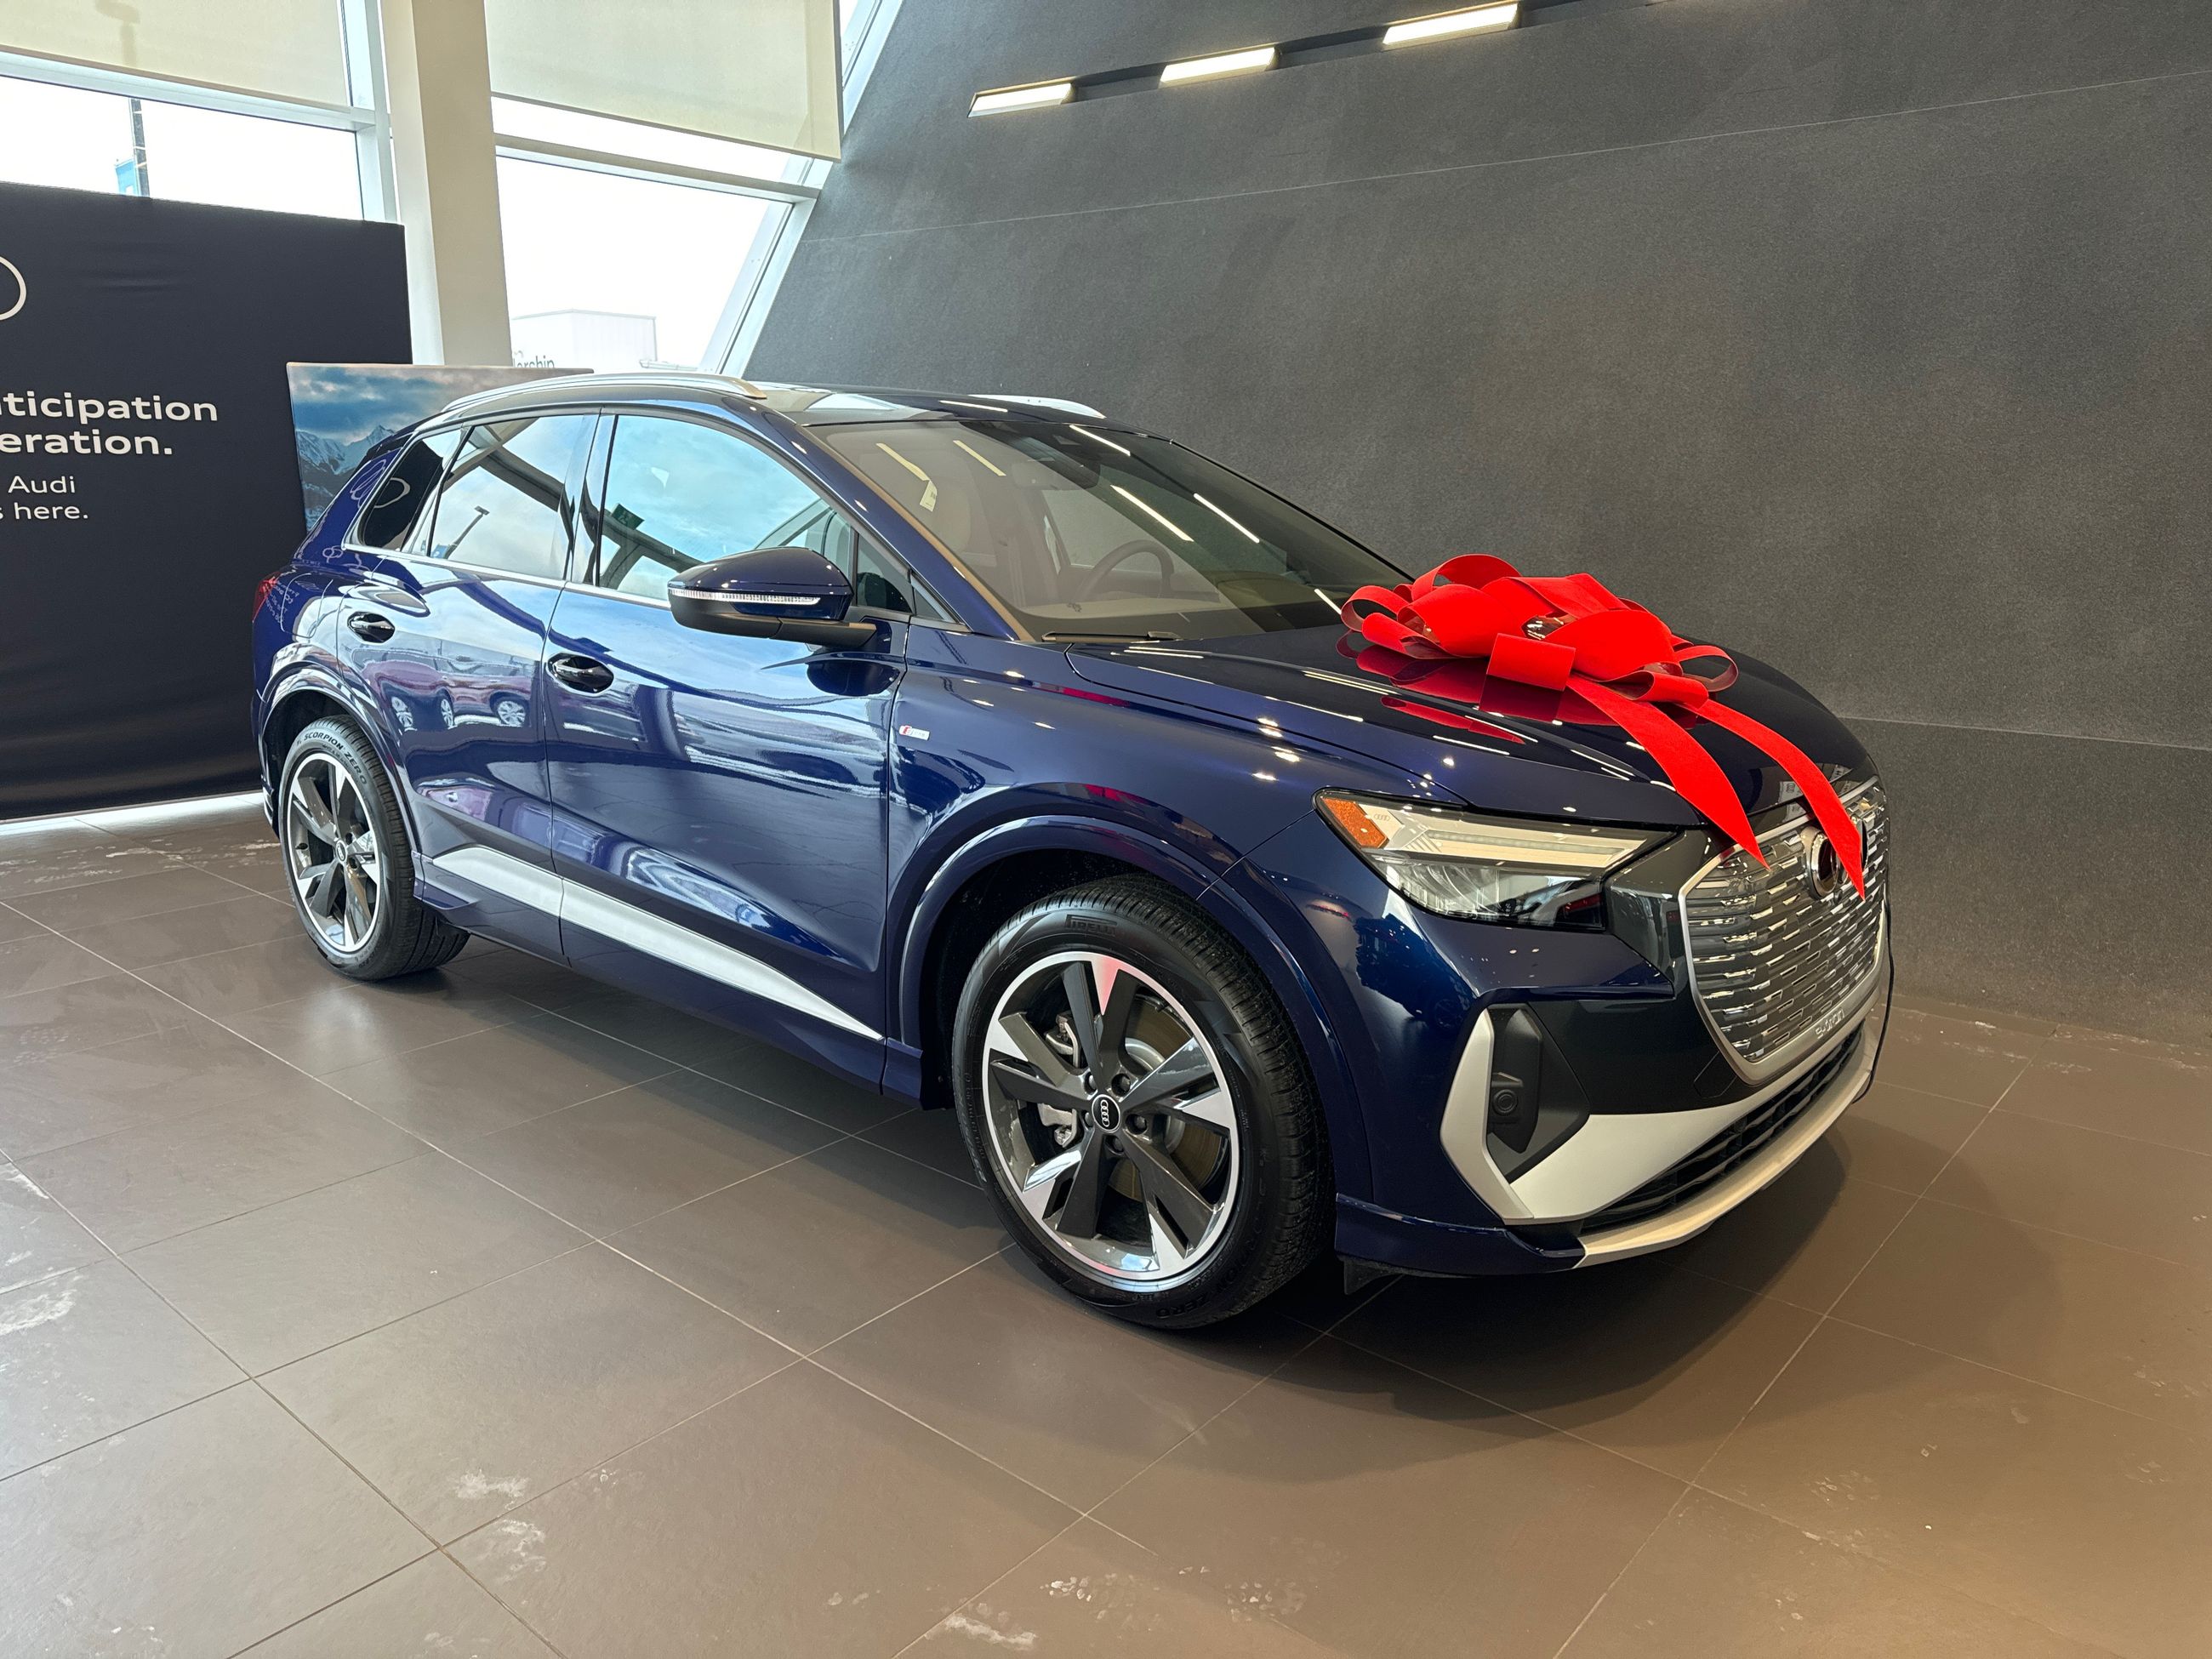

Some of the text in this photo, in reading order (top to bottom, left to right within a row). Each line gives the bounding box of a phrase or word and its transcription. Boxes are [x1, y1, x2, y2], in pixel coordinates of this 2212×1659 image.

[0, 391, 218, 425] ticipation
[8, 476, 76, 493] Audi
[14, 502, 88, 520] here.
[345, 751, 368, 784] ZERO
